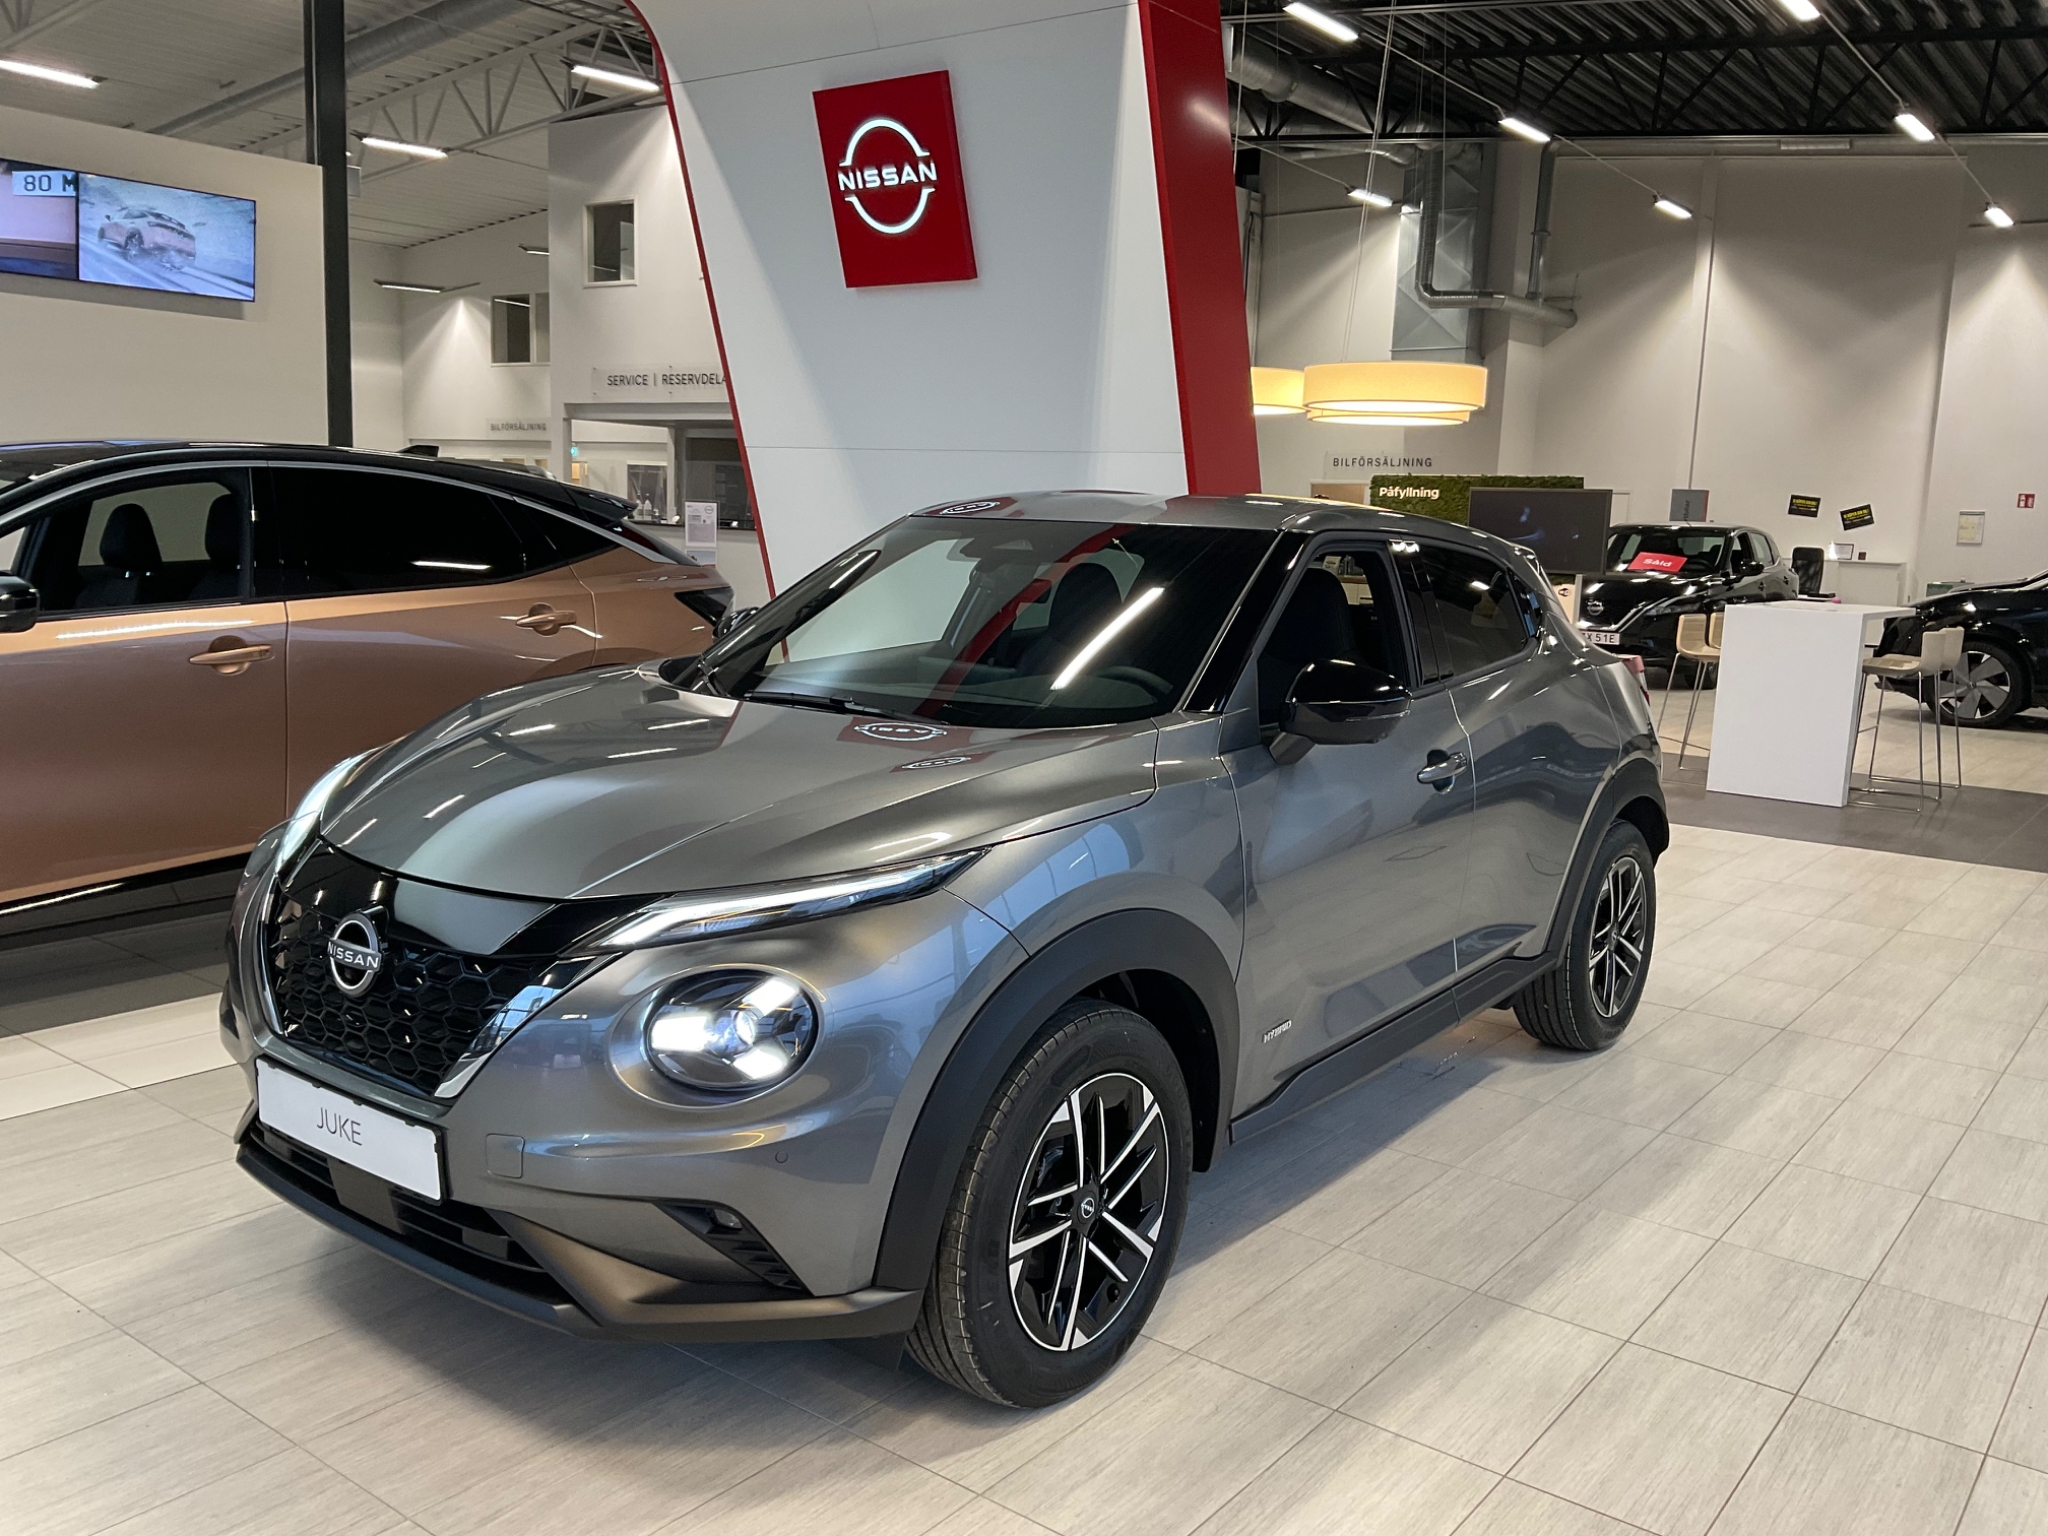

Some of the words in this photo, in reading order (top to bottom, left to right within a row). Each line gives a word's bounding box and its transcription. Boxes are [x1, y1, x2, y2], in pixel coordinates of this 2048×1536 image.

[24, 174, 52, 192] 80
[838, 162, 937, 191] NISSAN
[607, 374, 649, 386] SERVICE
[1333, 456, 1433, 468] BILFÖRSÄLJNING
[1379, 486, 1440, 500] Påfyllning
[1643, 558, 1673, 567] Såld
[327, 941, 379, 968] NISSAN
[316, 1106, 363, 1147] JUKE
